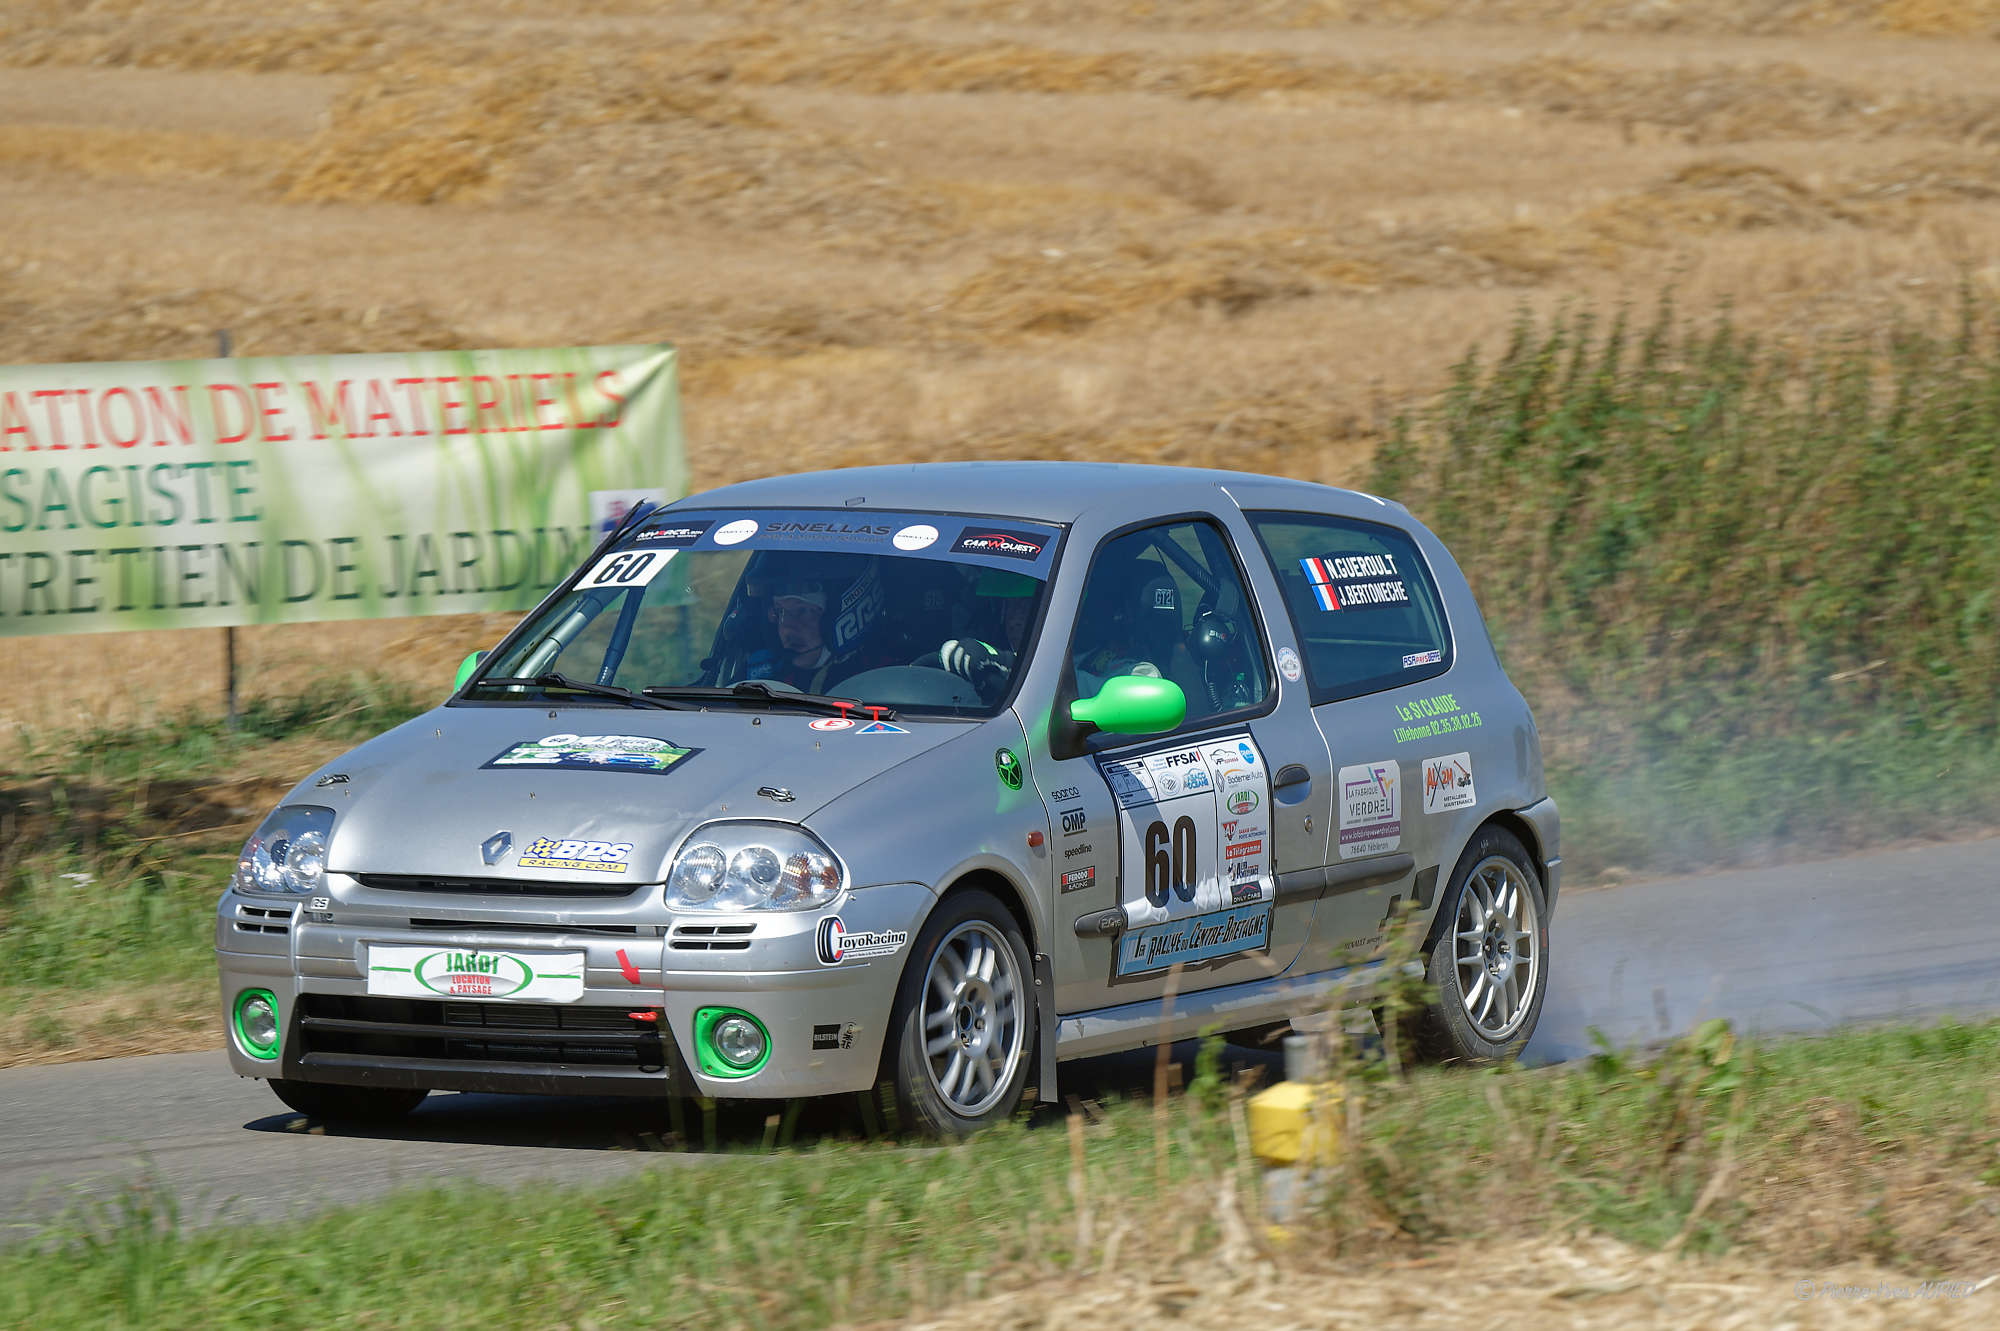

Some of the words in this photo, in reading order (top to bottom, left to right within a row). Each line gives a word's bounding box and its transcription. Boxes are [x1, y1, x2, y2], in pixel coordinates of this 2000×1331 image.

[0, 384, 194, 452] ATION
[210, 381, 289, 445] DE
[300, 369, 625, 440] MATERIELS
[0, 459, 262, 533] SAGISTE
[765, 523, 891, 535] SINELLAS
[279, 536, 364, 603] DE
[594, 552, 655, 586] 60
[1324, 554, 1397, 580] N.GUEROULT
[1338, 581, 1409, 606] J.BERTONECHE
[1395, 705, 1413, 721] Le
[1420, 694, 1460, 716] CLAUDE
[1165, 752, 1197, 768] FFSA
[1350, 798, 1390, 816] VERDREL
[1062, 812, 1086, 832] OMP
[549, 840, 634, 863] BPS
[1064, 843, 1093, 859] speedline
[1145, 816, 1197, 908] 60
[837, 931, 906, 949] ToyoRacing
[1147, 932, 1183, 964] RALLYE
[1188, 914, 1266, 949] CENTRE-BRETAGNE
[450, 986, 455, 995] &
[457, 984, 492, 995] PAYSAGE
[452, 975, 491, 985] LOCATION
